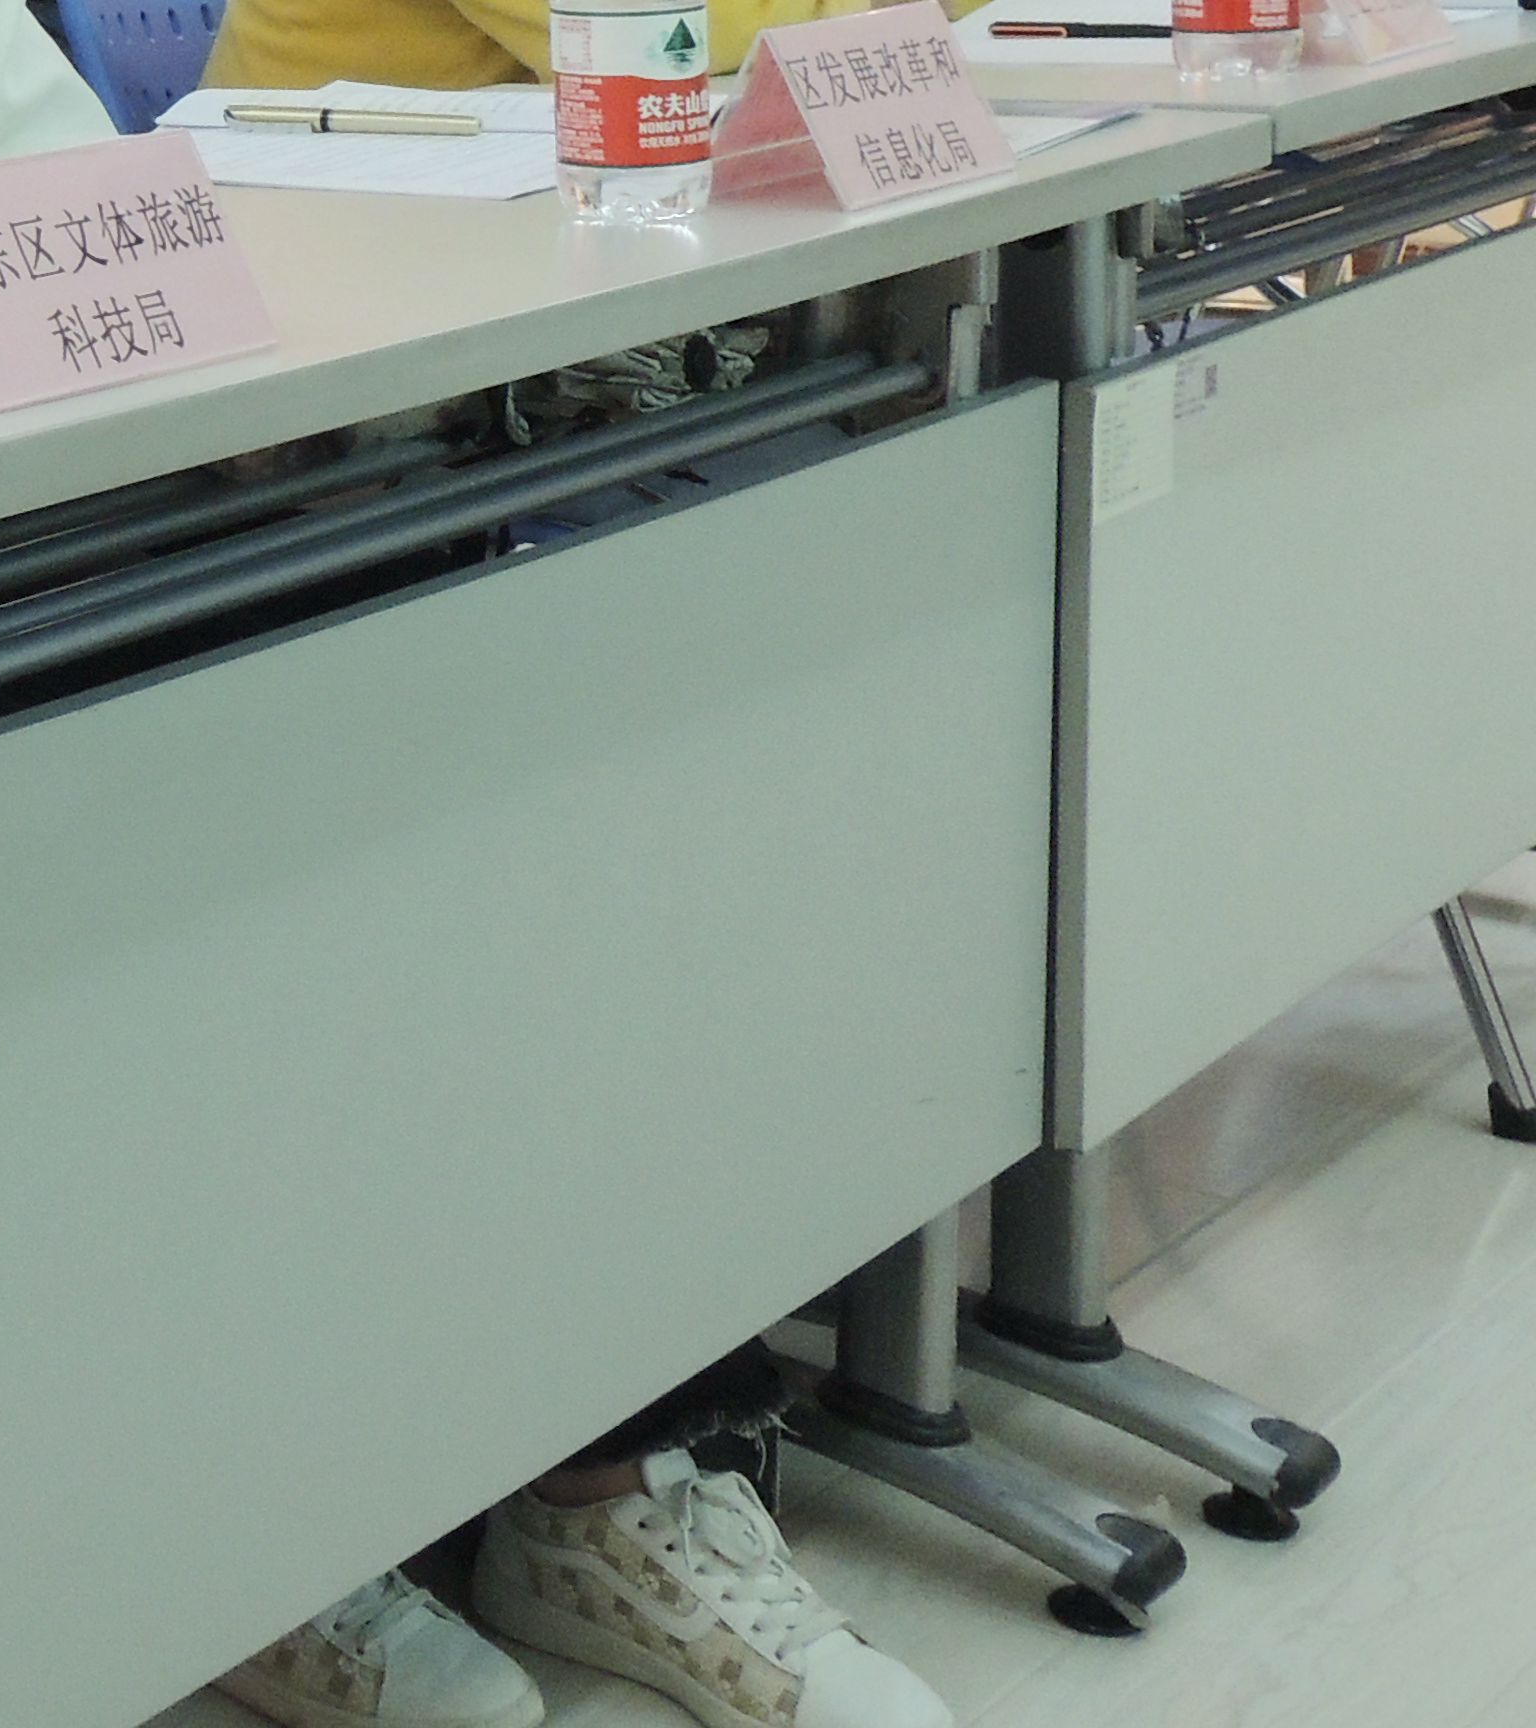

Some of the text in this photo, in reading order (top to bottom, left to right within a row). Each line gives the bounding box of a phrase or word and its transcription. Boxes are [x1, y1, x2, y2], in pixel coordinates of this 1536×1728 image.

[785, 36, 961, 110] 区发展改革和
[854, 119, 978, 191] 信息化局
[46, 289, 185, 373] 科技局
